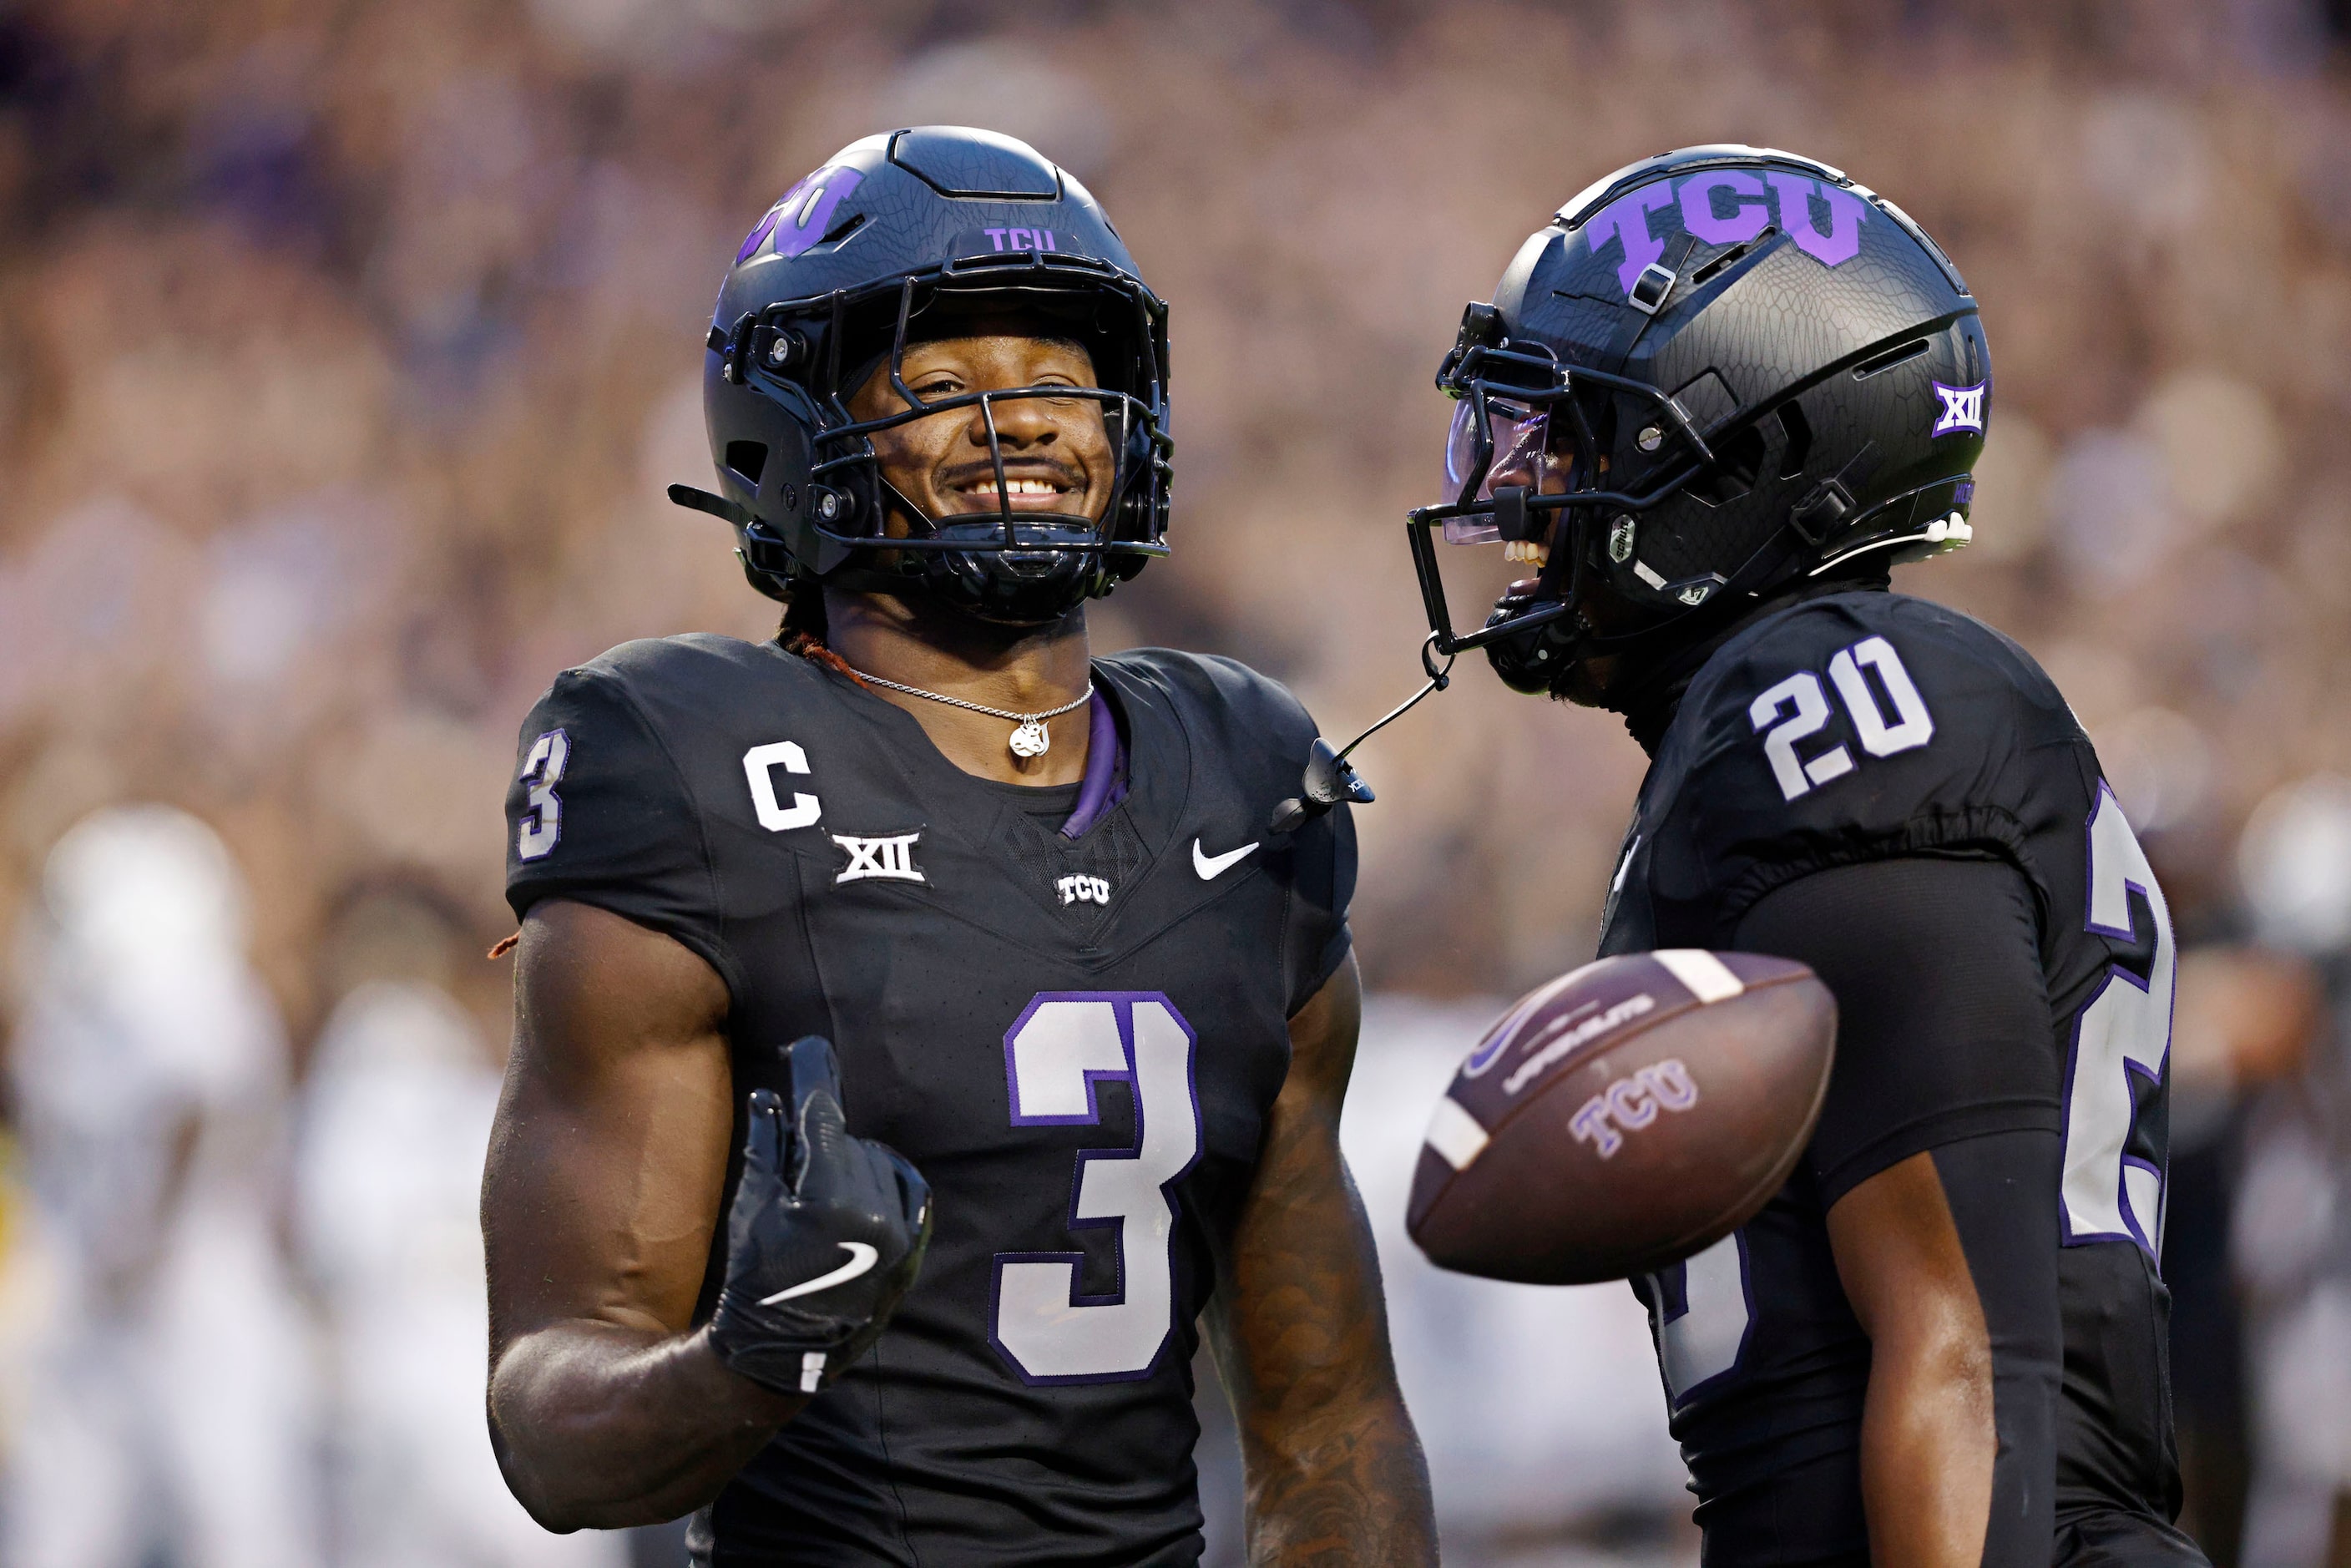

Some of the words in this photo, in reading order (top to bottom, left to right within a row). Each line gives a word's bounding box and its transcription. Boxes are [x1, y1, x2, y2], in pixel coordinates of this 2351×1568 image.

[983, 228, 1056, 252] TCU
[1585, 170, 1867, 296] TCU
[1935, 382, 1986, 432] XII
[1747, 634, 1936, 802] 20
[518, 727, 572, 865] 3
[742, 740, 822, 832] C
[832, 832, 927, 884] XII
[1055, 874, 1110, 905] TCU
[1567, 1058, 1699, 1160] TCU
[988, 991, 1204, 1388] 3
